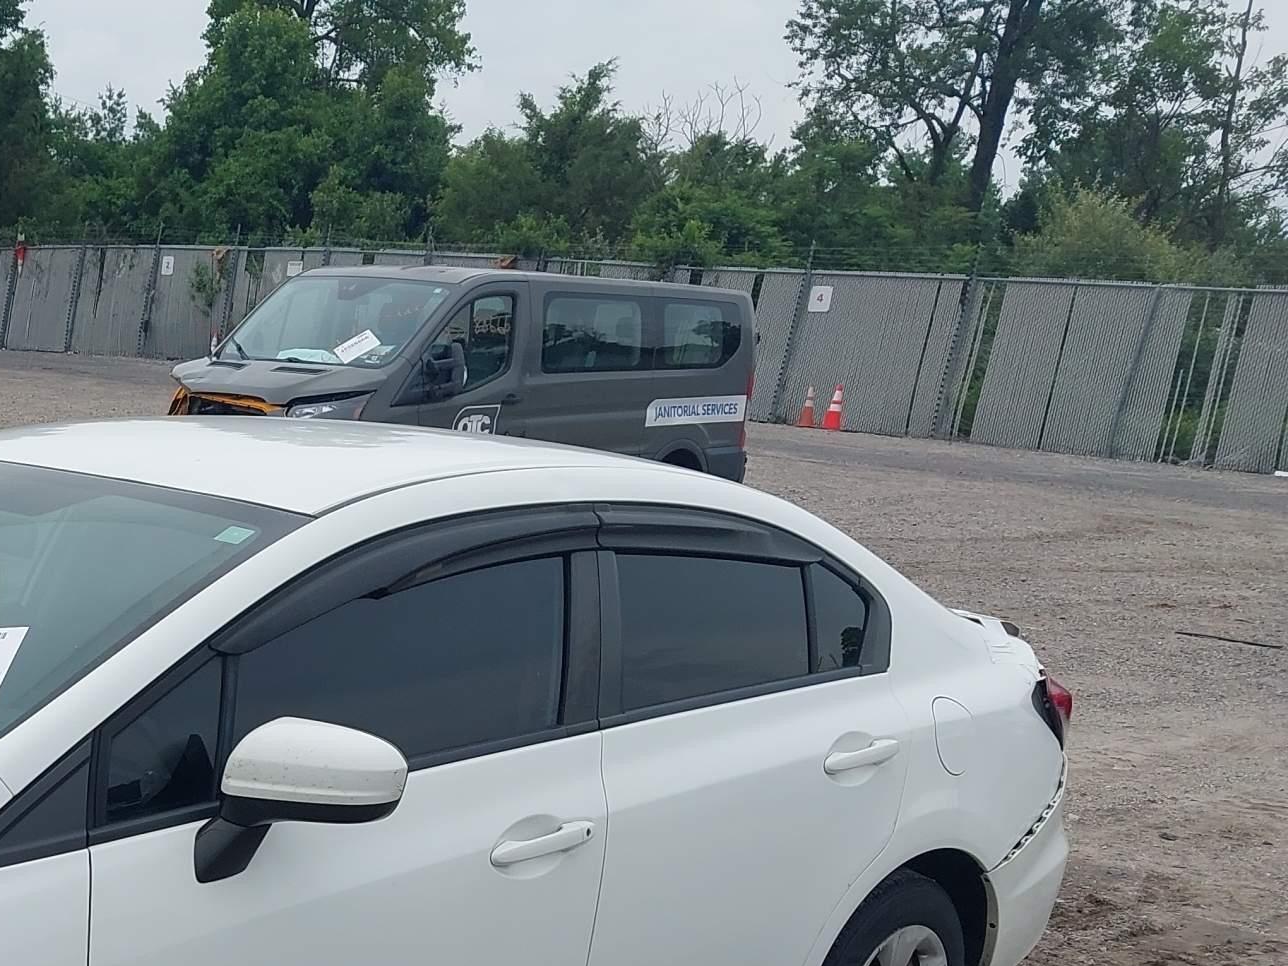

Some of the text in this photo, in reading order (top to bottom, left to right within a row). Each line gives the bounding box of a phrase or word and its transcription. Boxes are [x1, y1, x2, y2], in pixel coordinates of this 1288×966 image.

[816, 293, 824, 304] 4
[654, 403, 738, 422] JANITORIAL SERVICES
